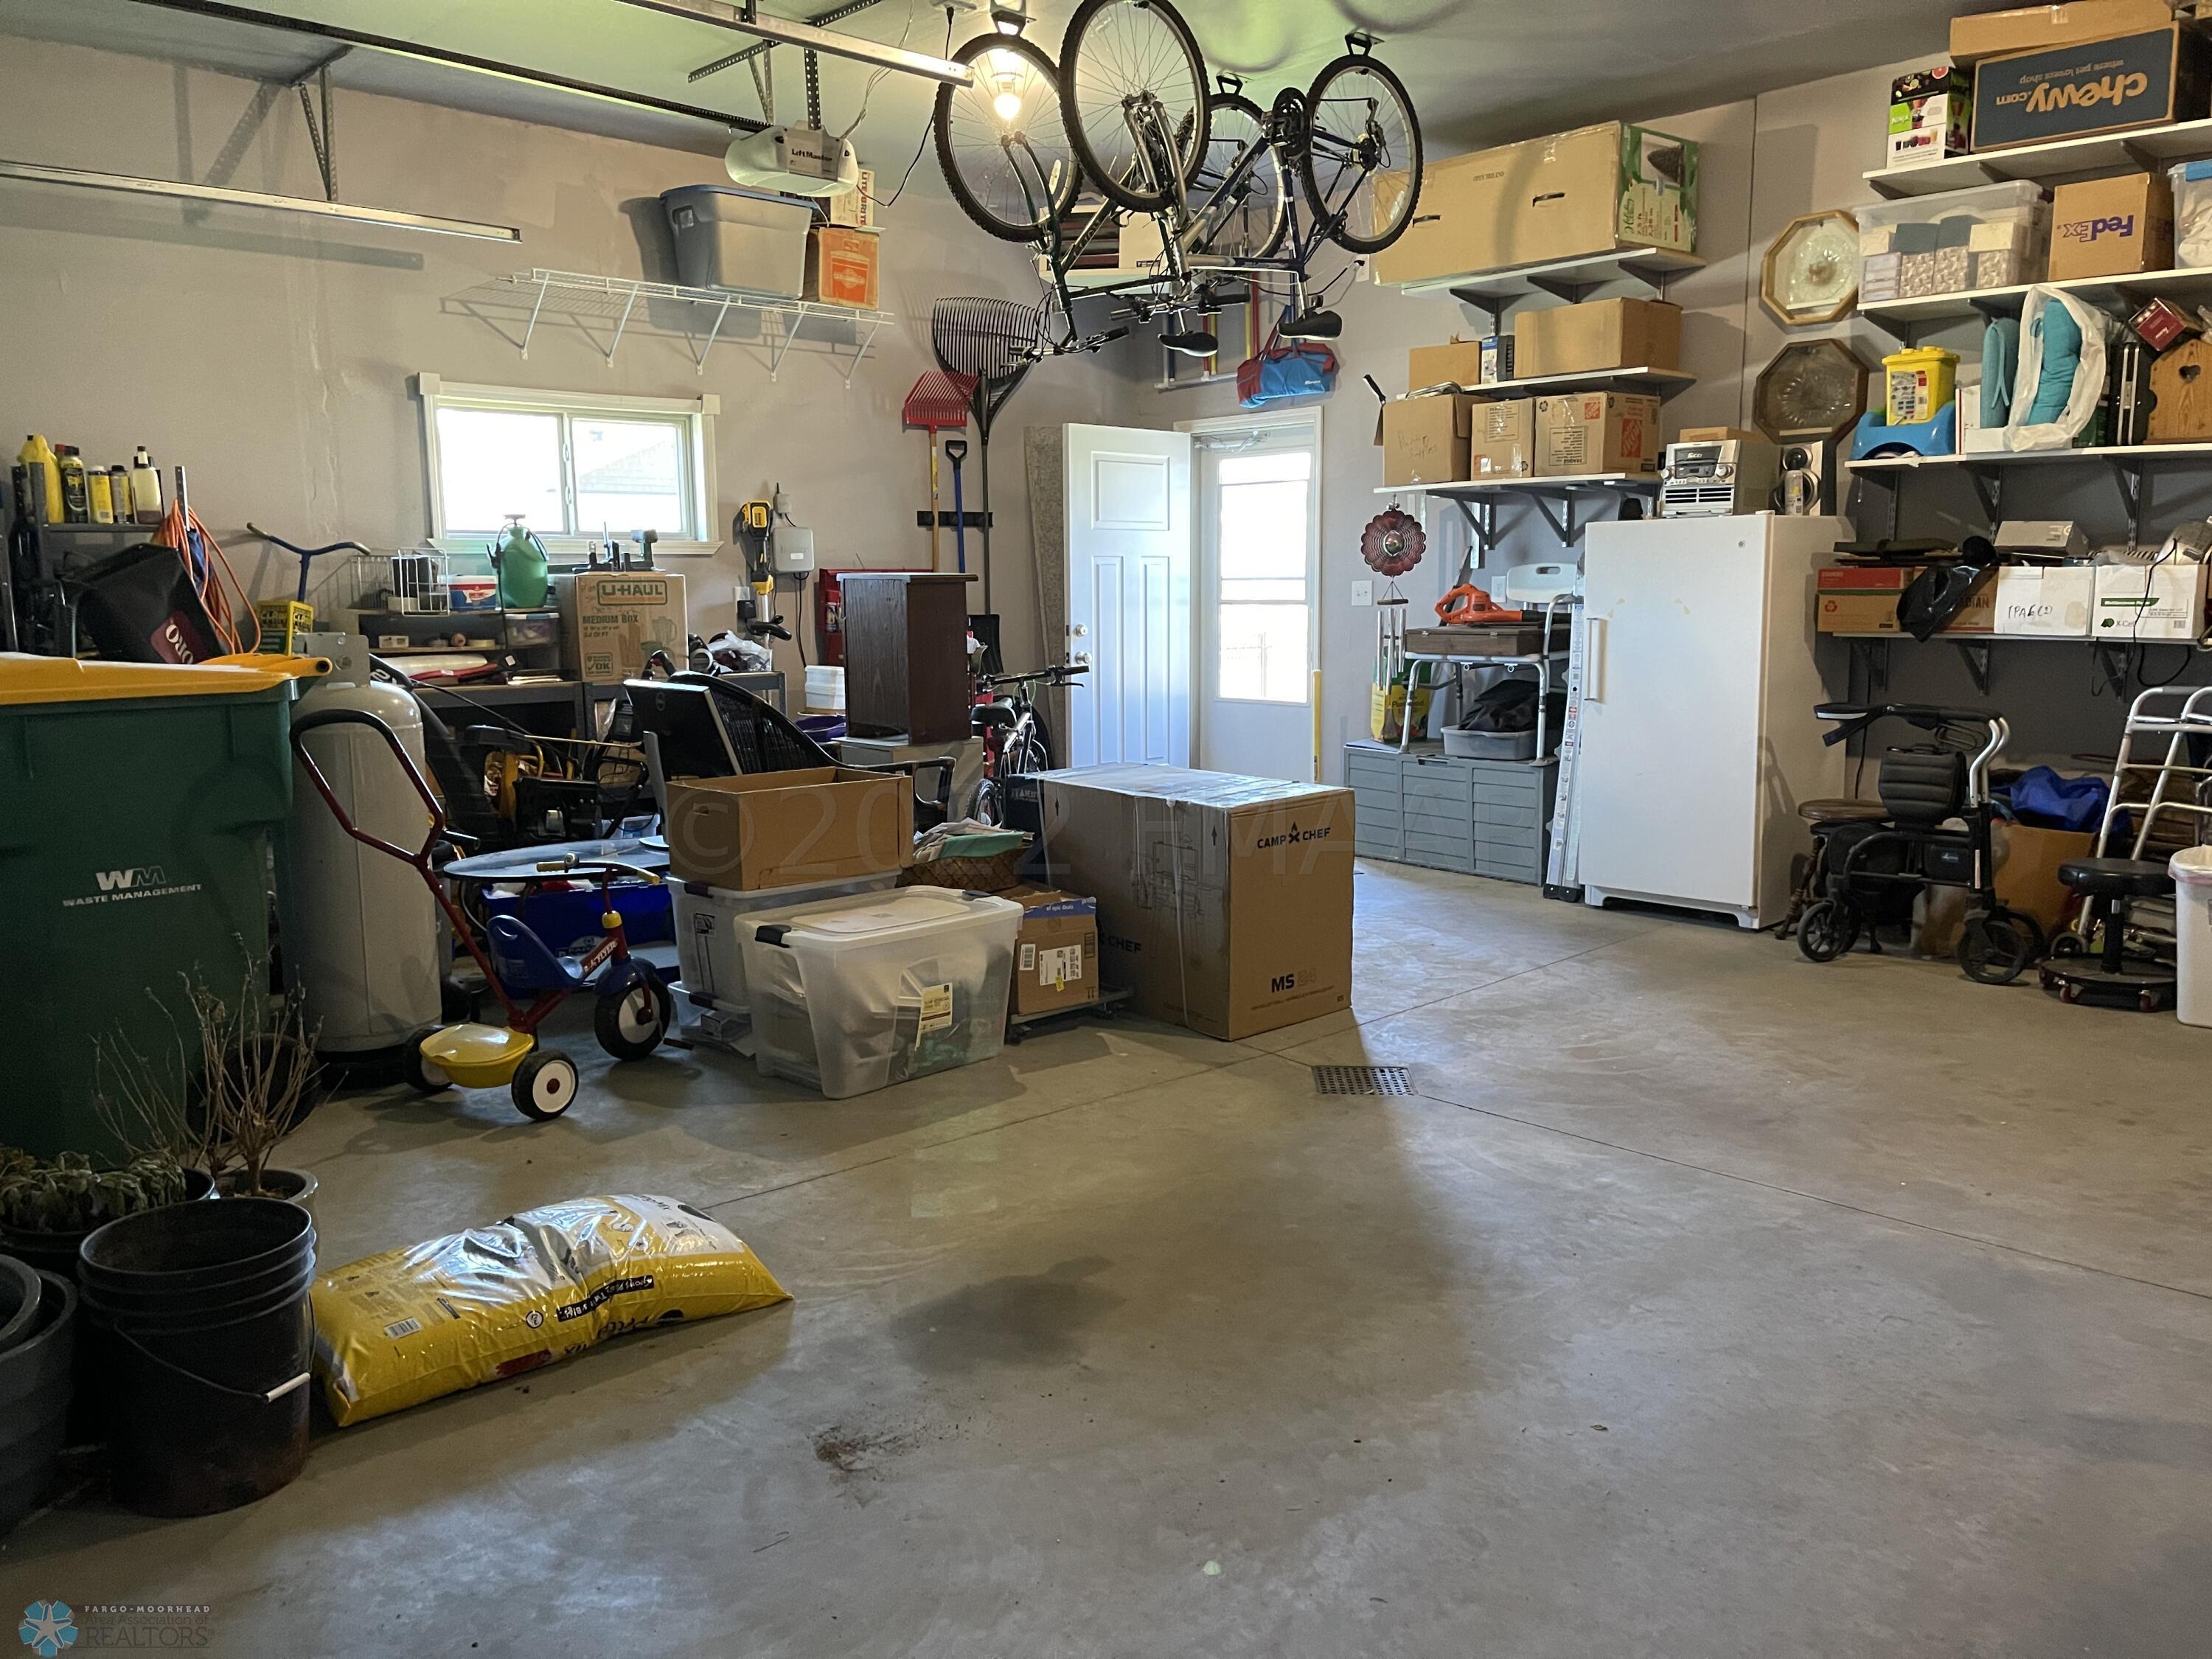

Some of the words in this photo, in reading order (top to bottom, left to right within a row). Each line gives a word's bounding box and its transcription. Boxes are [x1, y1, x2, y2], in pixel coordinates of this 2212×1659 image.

[791, 148, 833, 162] LiftMaster
[2062, 214, 2135, 243] FedEx
[601, 584, 663, 597] U-HAUL
[582, 615, 619, 625] MEDIUM
[165, 624, 194, 664] ORO
[1256, 835, 1287, 849] CAMP
[1302, 827, 1331, 841] CHEF
[95, 865, 167, 891] WM
[62, 894, 108, 907] WASTE
[111, 883, 203, 901] MANAGEMENT
[1107, 935, 1143, 954] CHEF
[1271, 973, 1295, 993] MS
